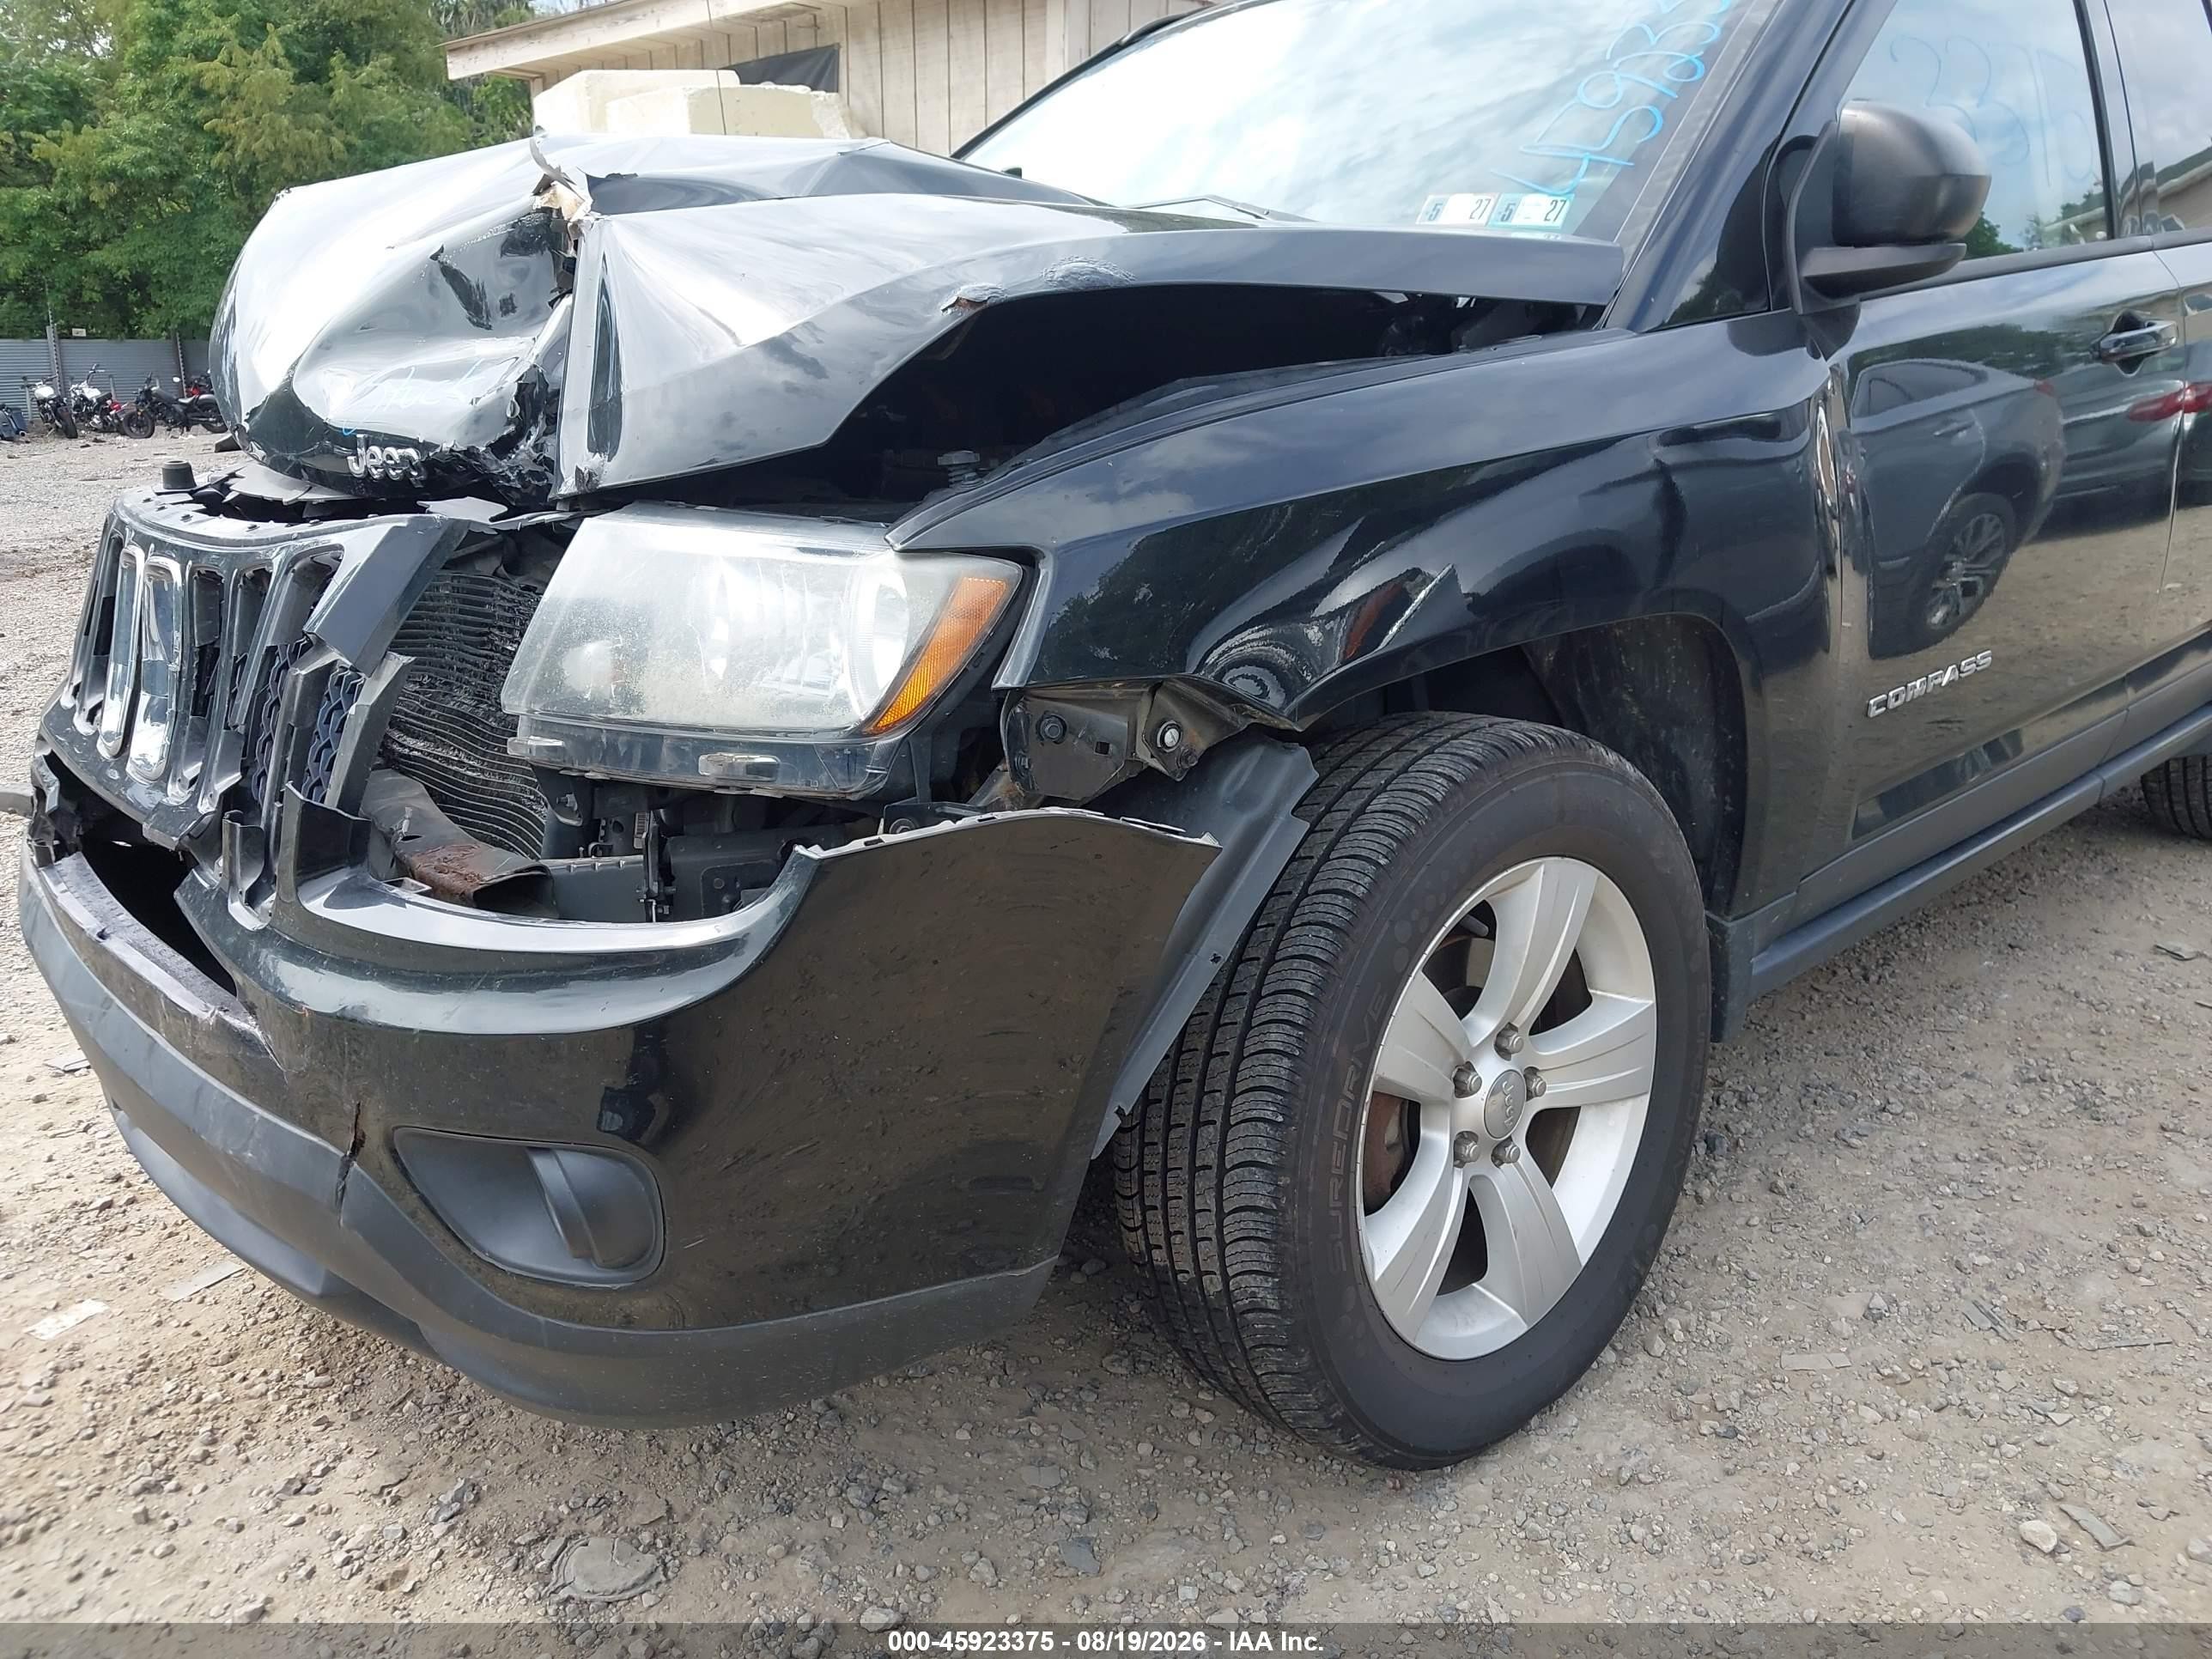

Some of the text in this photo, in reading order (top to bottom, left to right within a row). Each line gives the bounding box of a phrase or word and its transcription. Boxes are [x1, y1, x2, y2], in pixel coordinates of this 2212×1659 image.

[1468, 198, 1492, 221] 27
[1543, 198, 1568, 222] 27
[1867, 648, 1993, 719] COMPASS
